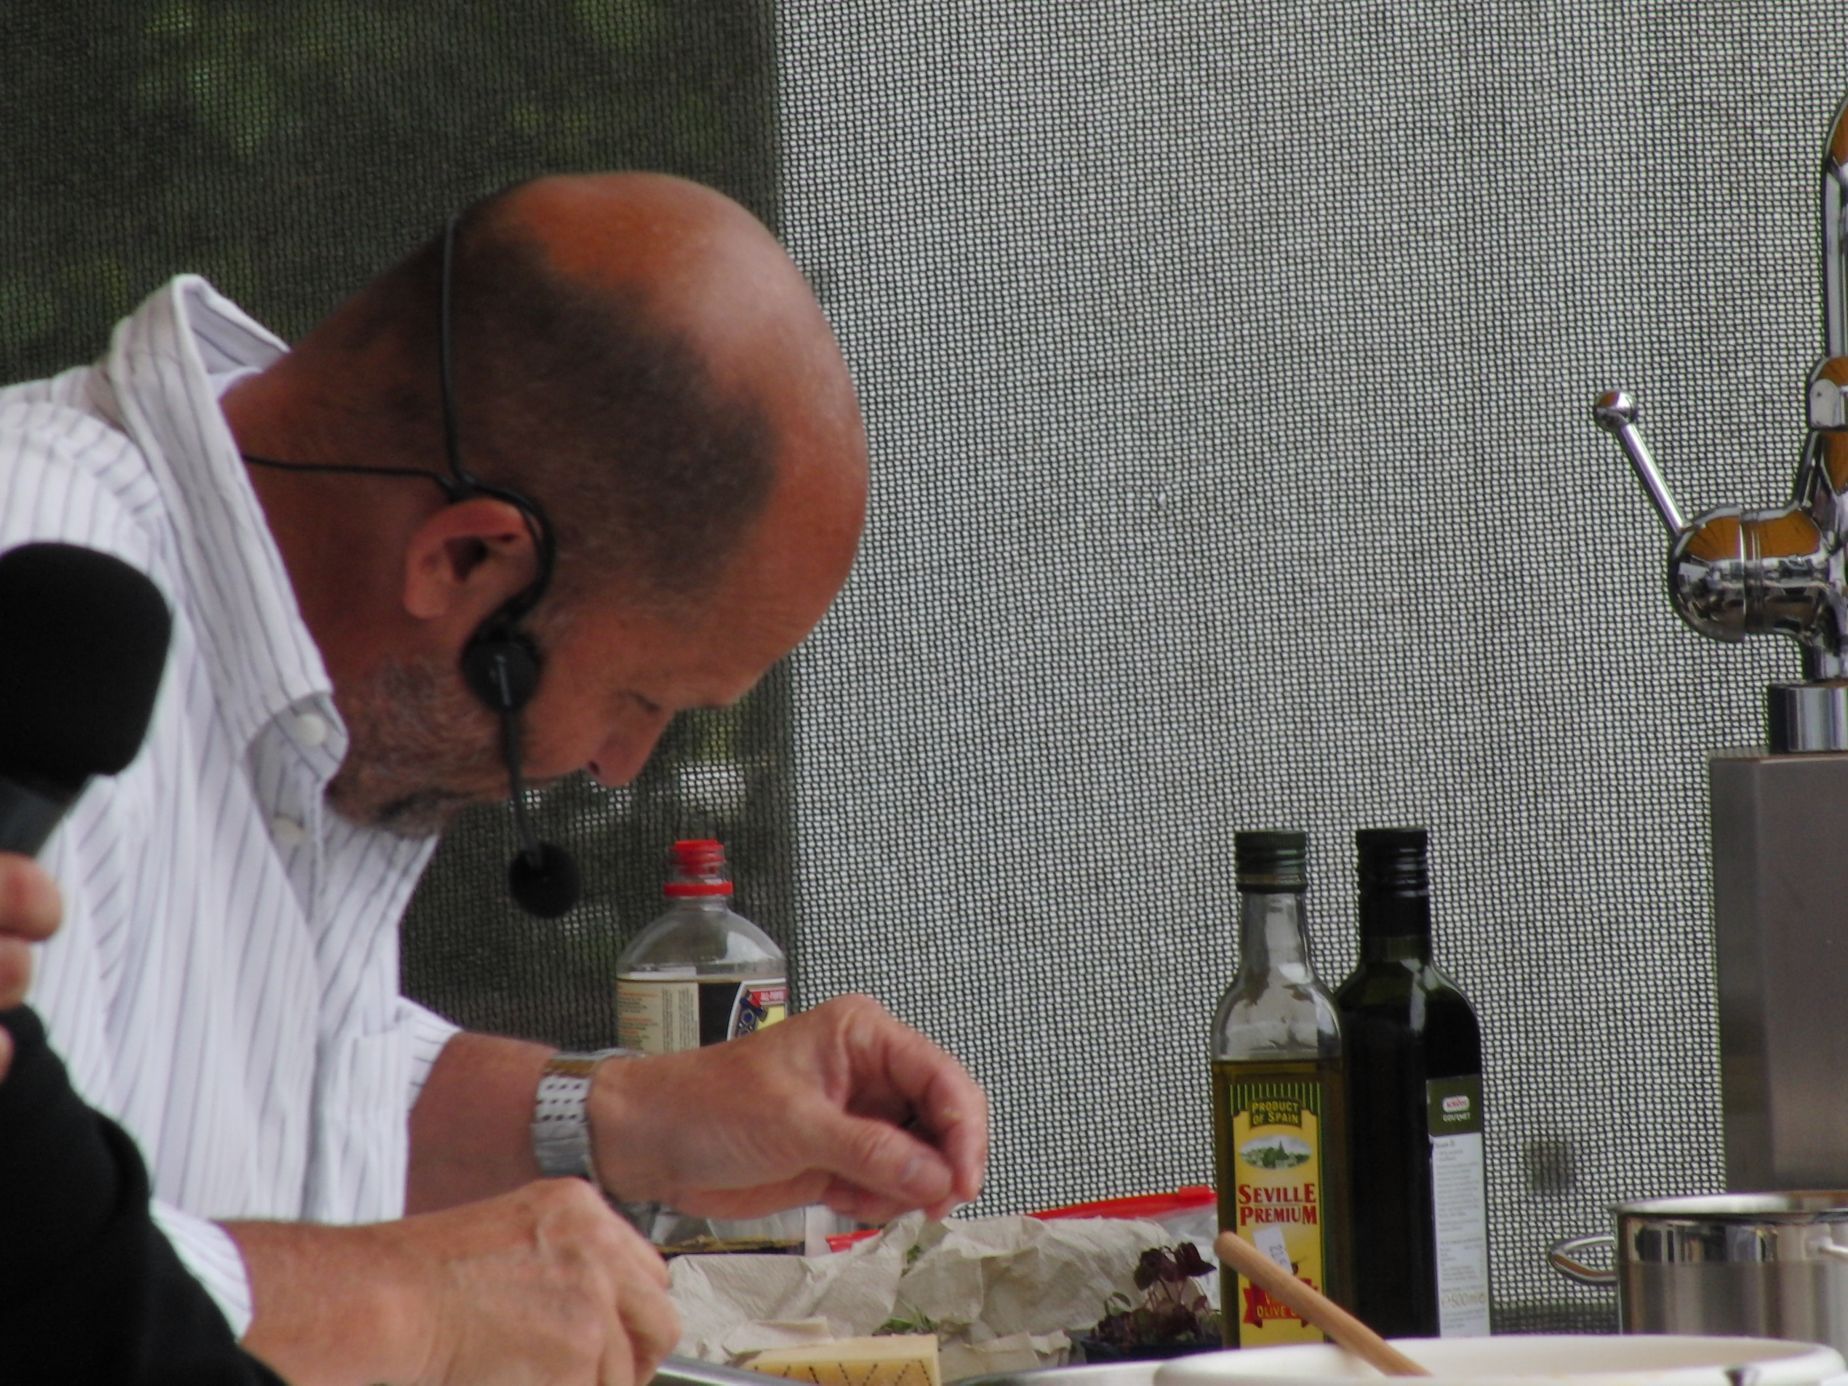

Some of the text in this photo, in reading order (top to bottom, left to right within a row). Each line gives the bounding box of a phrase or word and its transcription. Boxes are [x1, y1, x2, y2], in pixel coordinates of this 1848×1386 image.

[1251, 1101, 1299, 1113] PRODUCT
[1267, 1110, 1299, 1124] SPAIN
[1238, 1183, 1316, 1204] SEVILLE
[1240, 1205, 1317, 1226] PREMIUM
[1256, 1305, 1287, 1318] OLIVE
